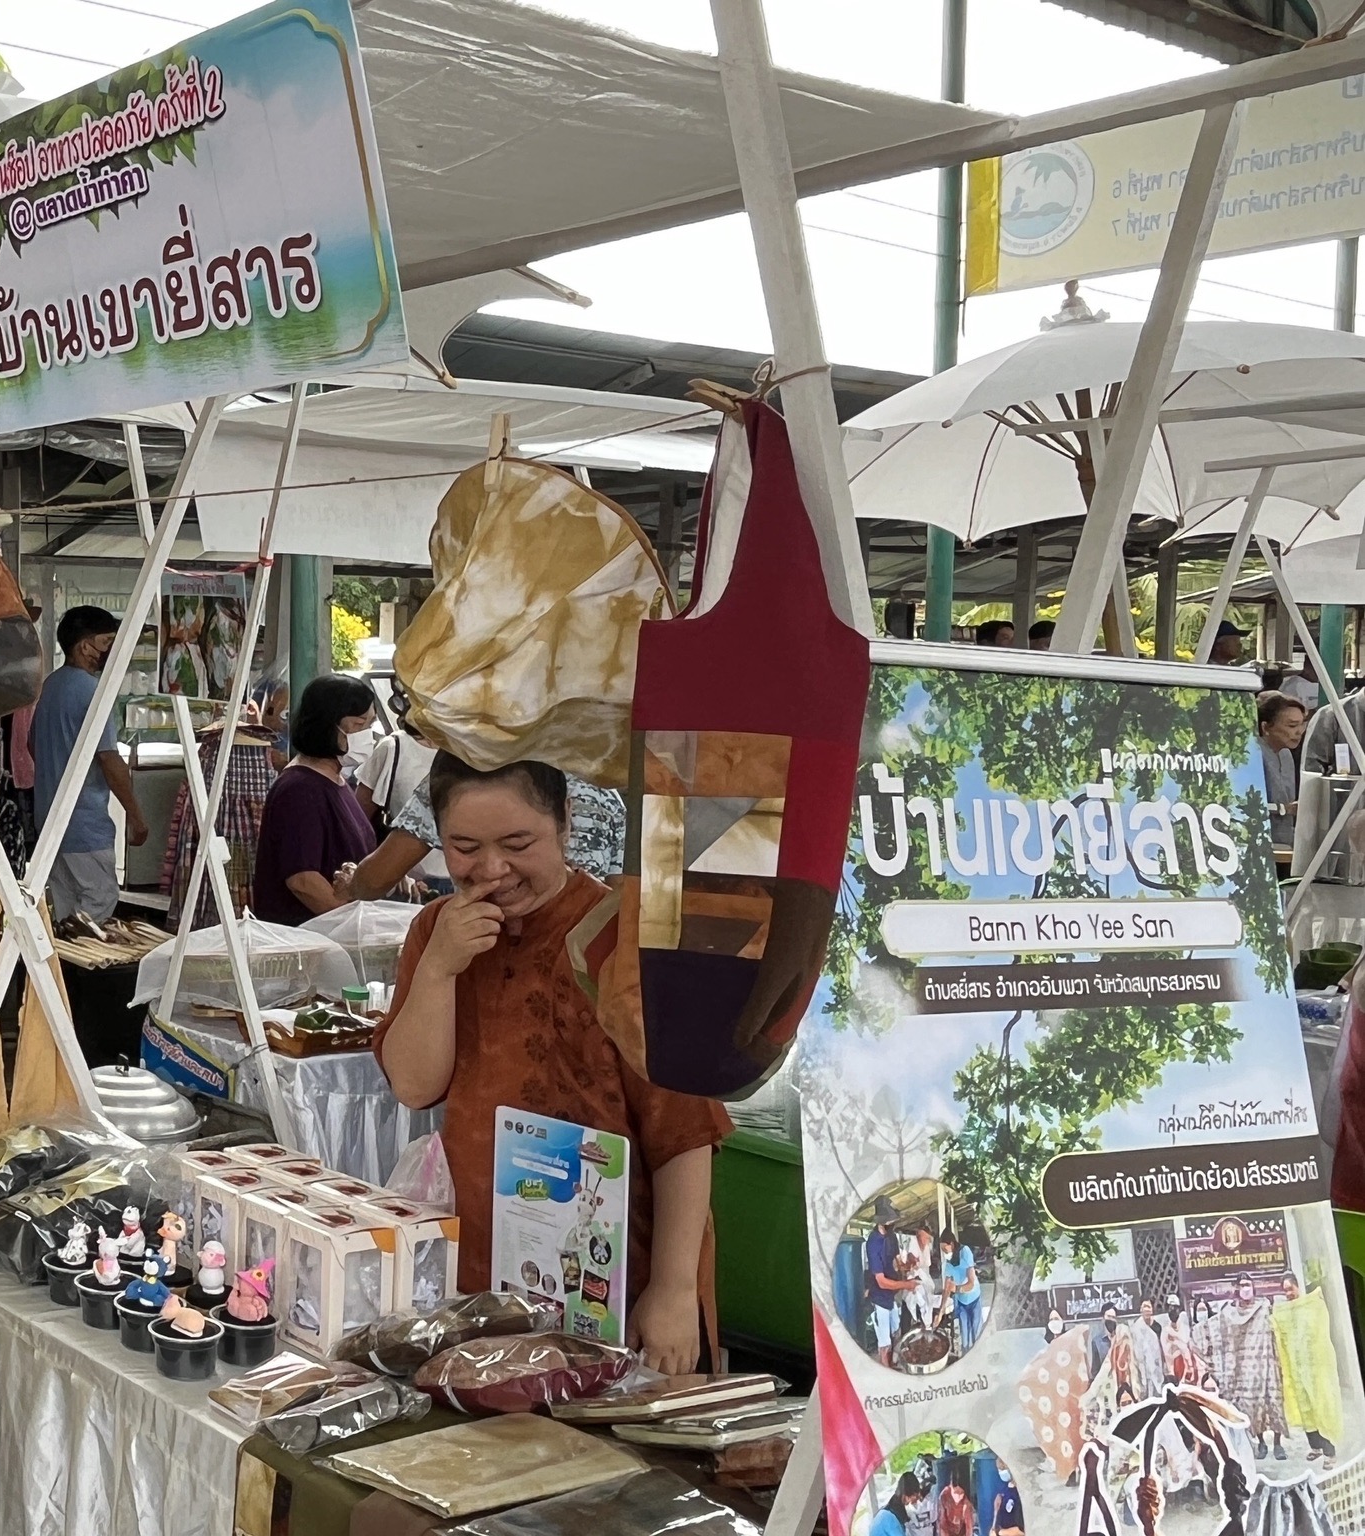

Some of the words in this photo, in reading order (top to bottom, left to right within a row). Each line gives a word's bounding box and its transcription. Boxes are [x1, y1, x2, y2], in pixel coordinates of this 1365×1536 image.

[38, 95, 152, 176] อาหารปลอดภัย
[206, 70, 221, 113] 2
[858, 748, 1240, 877] บ้านเขายี่สาร
[969, 915, 1026, 942] Bann
[1035, 913, 1082, 940] Kho
[1087, 913, 1125, 939] Yee
[1131, 913, 1175, 938] San
[925, 972, 991, 1001] ตำบลยี่สาร
[996, 974, 1090, 998] อำเภออัมพวา
[1093, 973, 1221, 999] จังหวัดสมุทรสงคราม
[1069, 1155, 1319, 1203] ผลิตภัณฑ์ผ้ามัดย้อมสีธรรมชาติ
